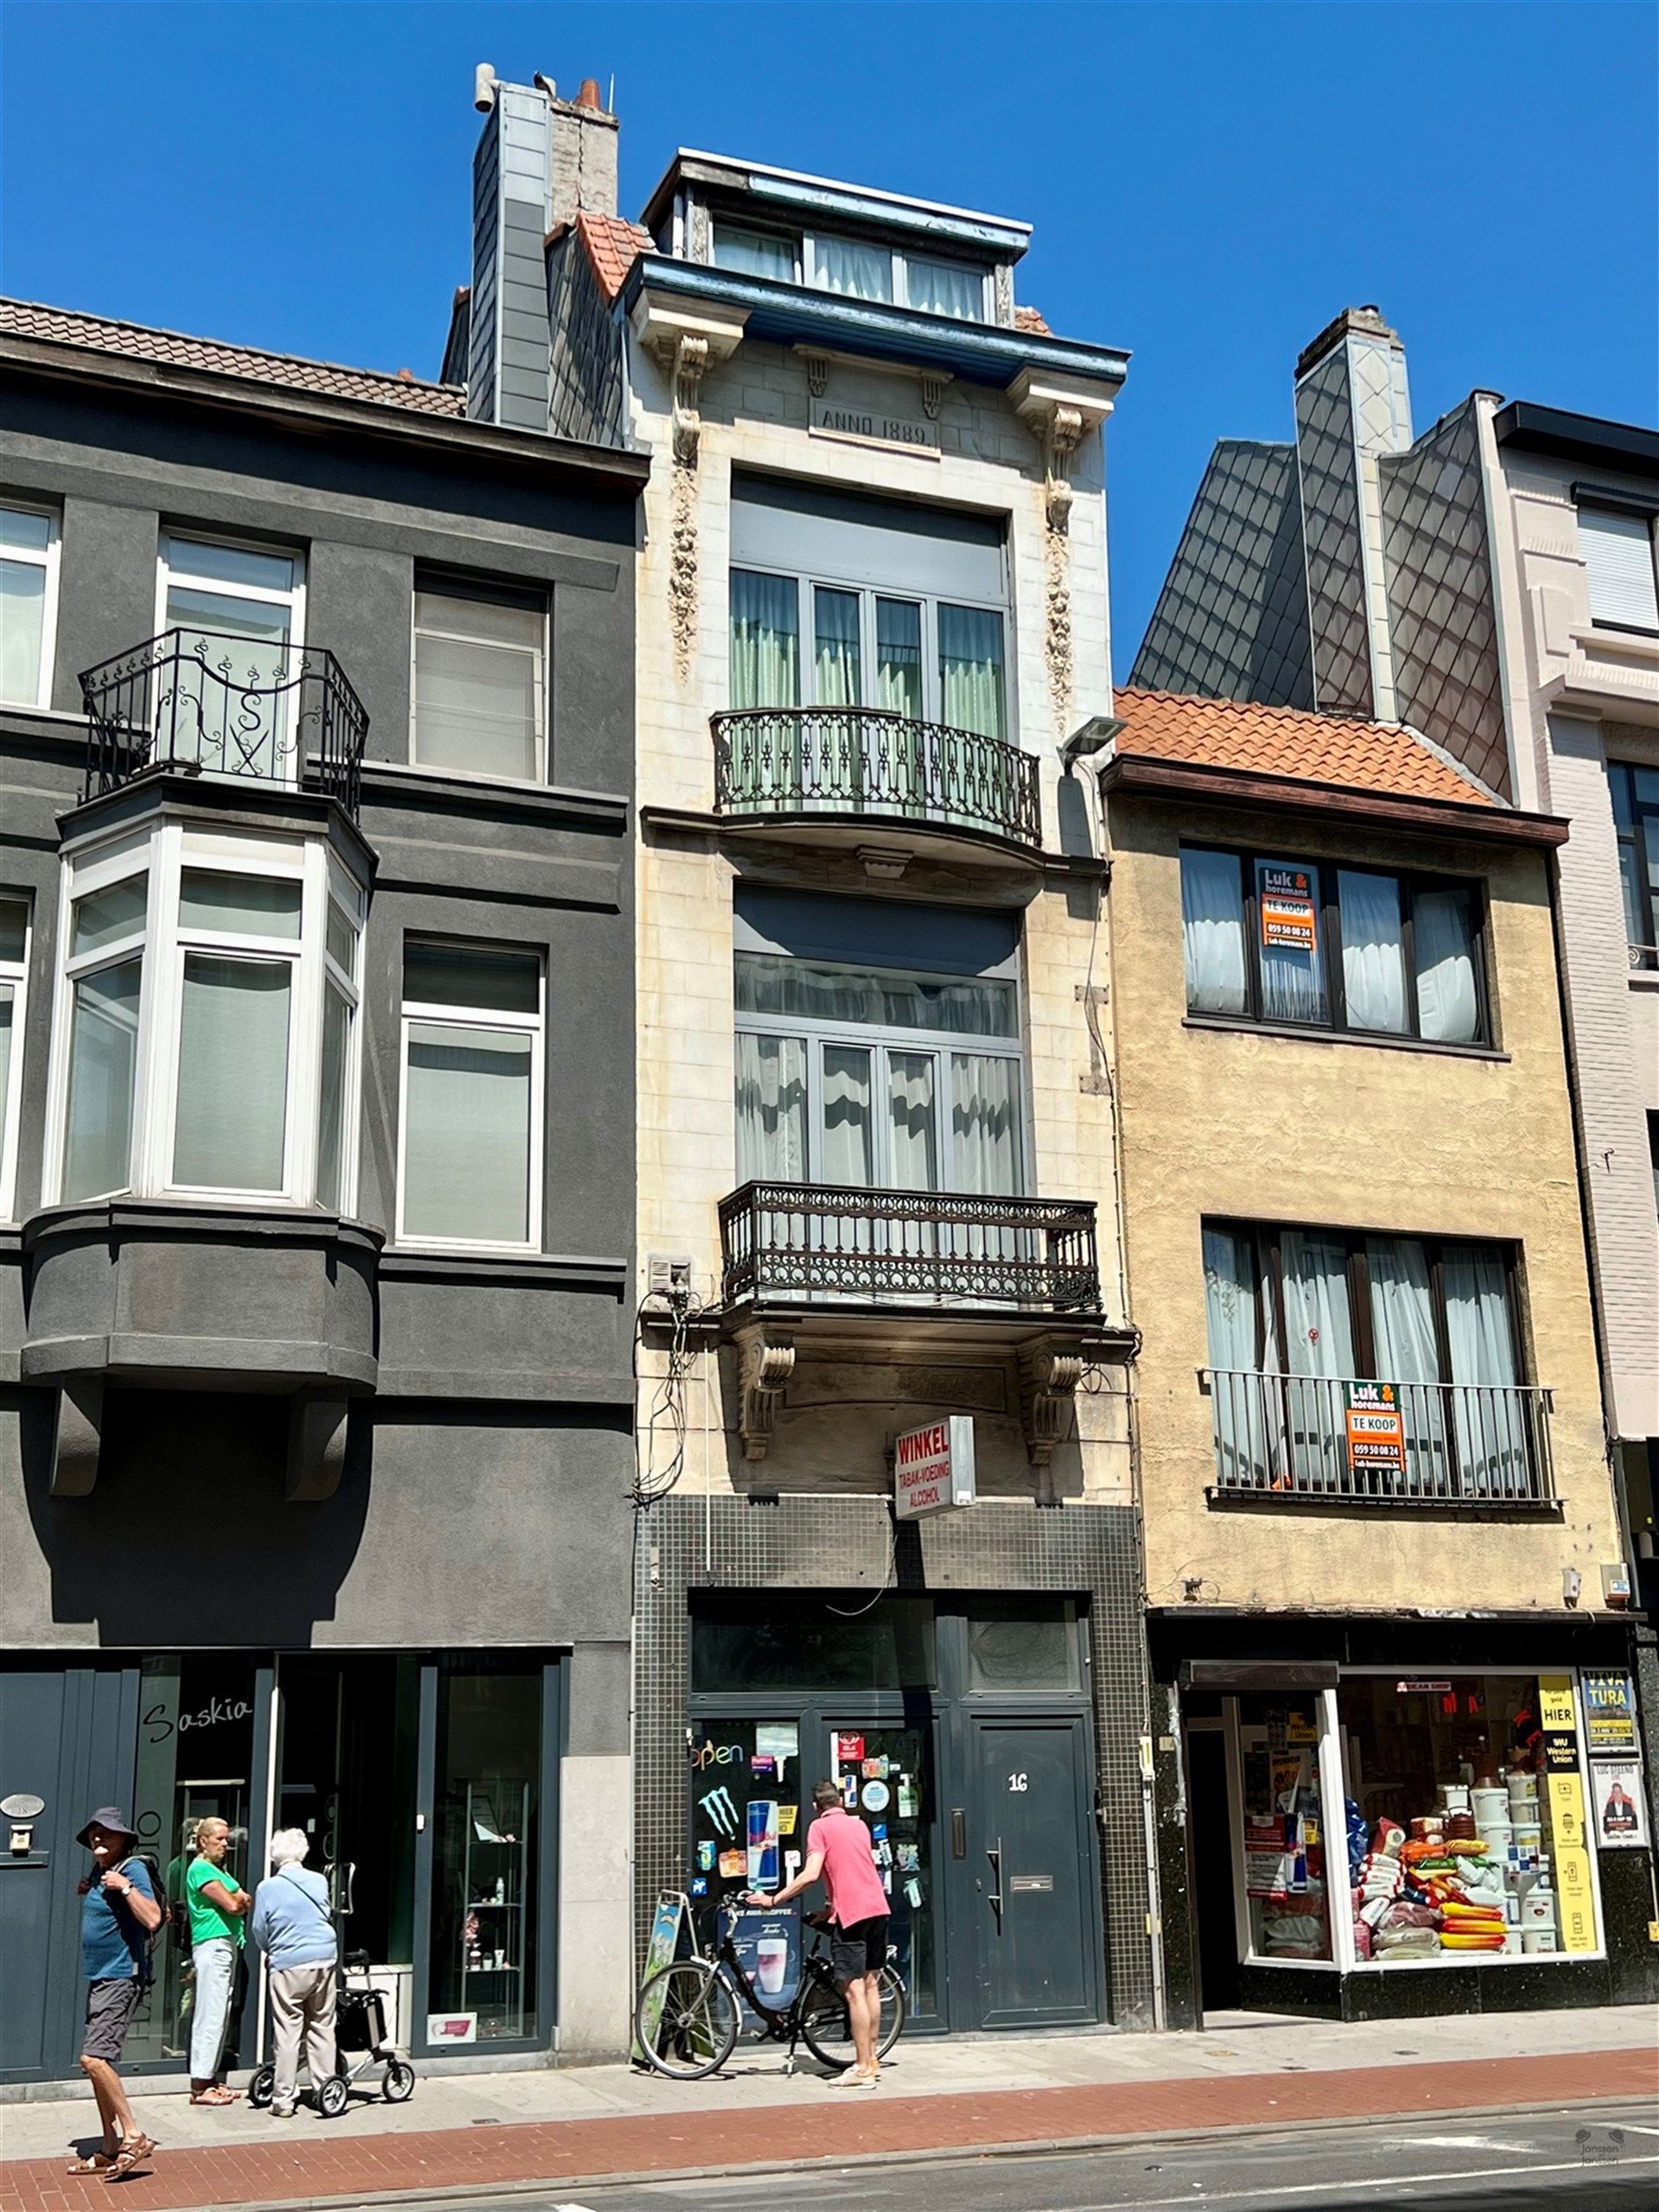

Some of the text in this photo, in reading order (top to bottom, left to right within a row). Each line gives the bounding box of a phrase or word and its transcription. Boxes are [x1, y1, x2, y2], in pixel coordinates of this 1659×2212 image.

[823, 410, 855, 435] ANNO
[1264, 869, 1307, 889] Luk &
[1266, 885, 1308, 898] horemans
[1267, 899, 1309, 914] TE KOOP
[1301, 928, 1311, 938] 24
[1349, 1382, 1394, 1402] Luk &
[1351, 1400, 1395, 1411] horemans
[1353, 1418, 1396, 1431] TE KOOP
[899, 1425, 949, 1465] WINKEL
[1354, 1444, 1369, 1454] 059
[1370, 1445, 1378, 1455] 50
[1389, 1446, 1399, 1456] 24
[899, 1460, 950, 1490] TABAK-VOEDING
[910, 1486, 940, 1509] ALCOHOL
[1587, 1671, 1625, 1686] VIVA
[1588, 1688, 1627, 1706] TURA
[143, 1696, 253, 1744] Saskia
[1544, 1708, 1573, 1721] HIER
[1546, 1746, 1577, 1756] Western
[1552, 1755, 1573, 1764] Union
[1008, 1772, 1028, 1792] 16
